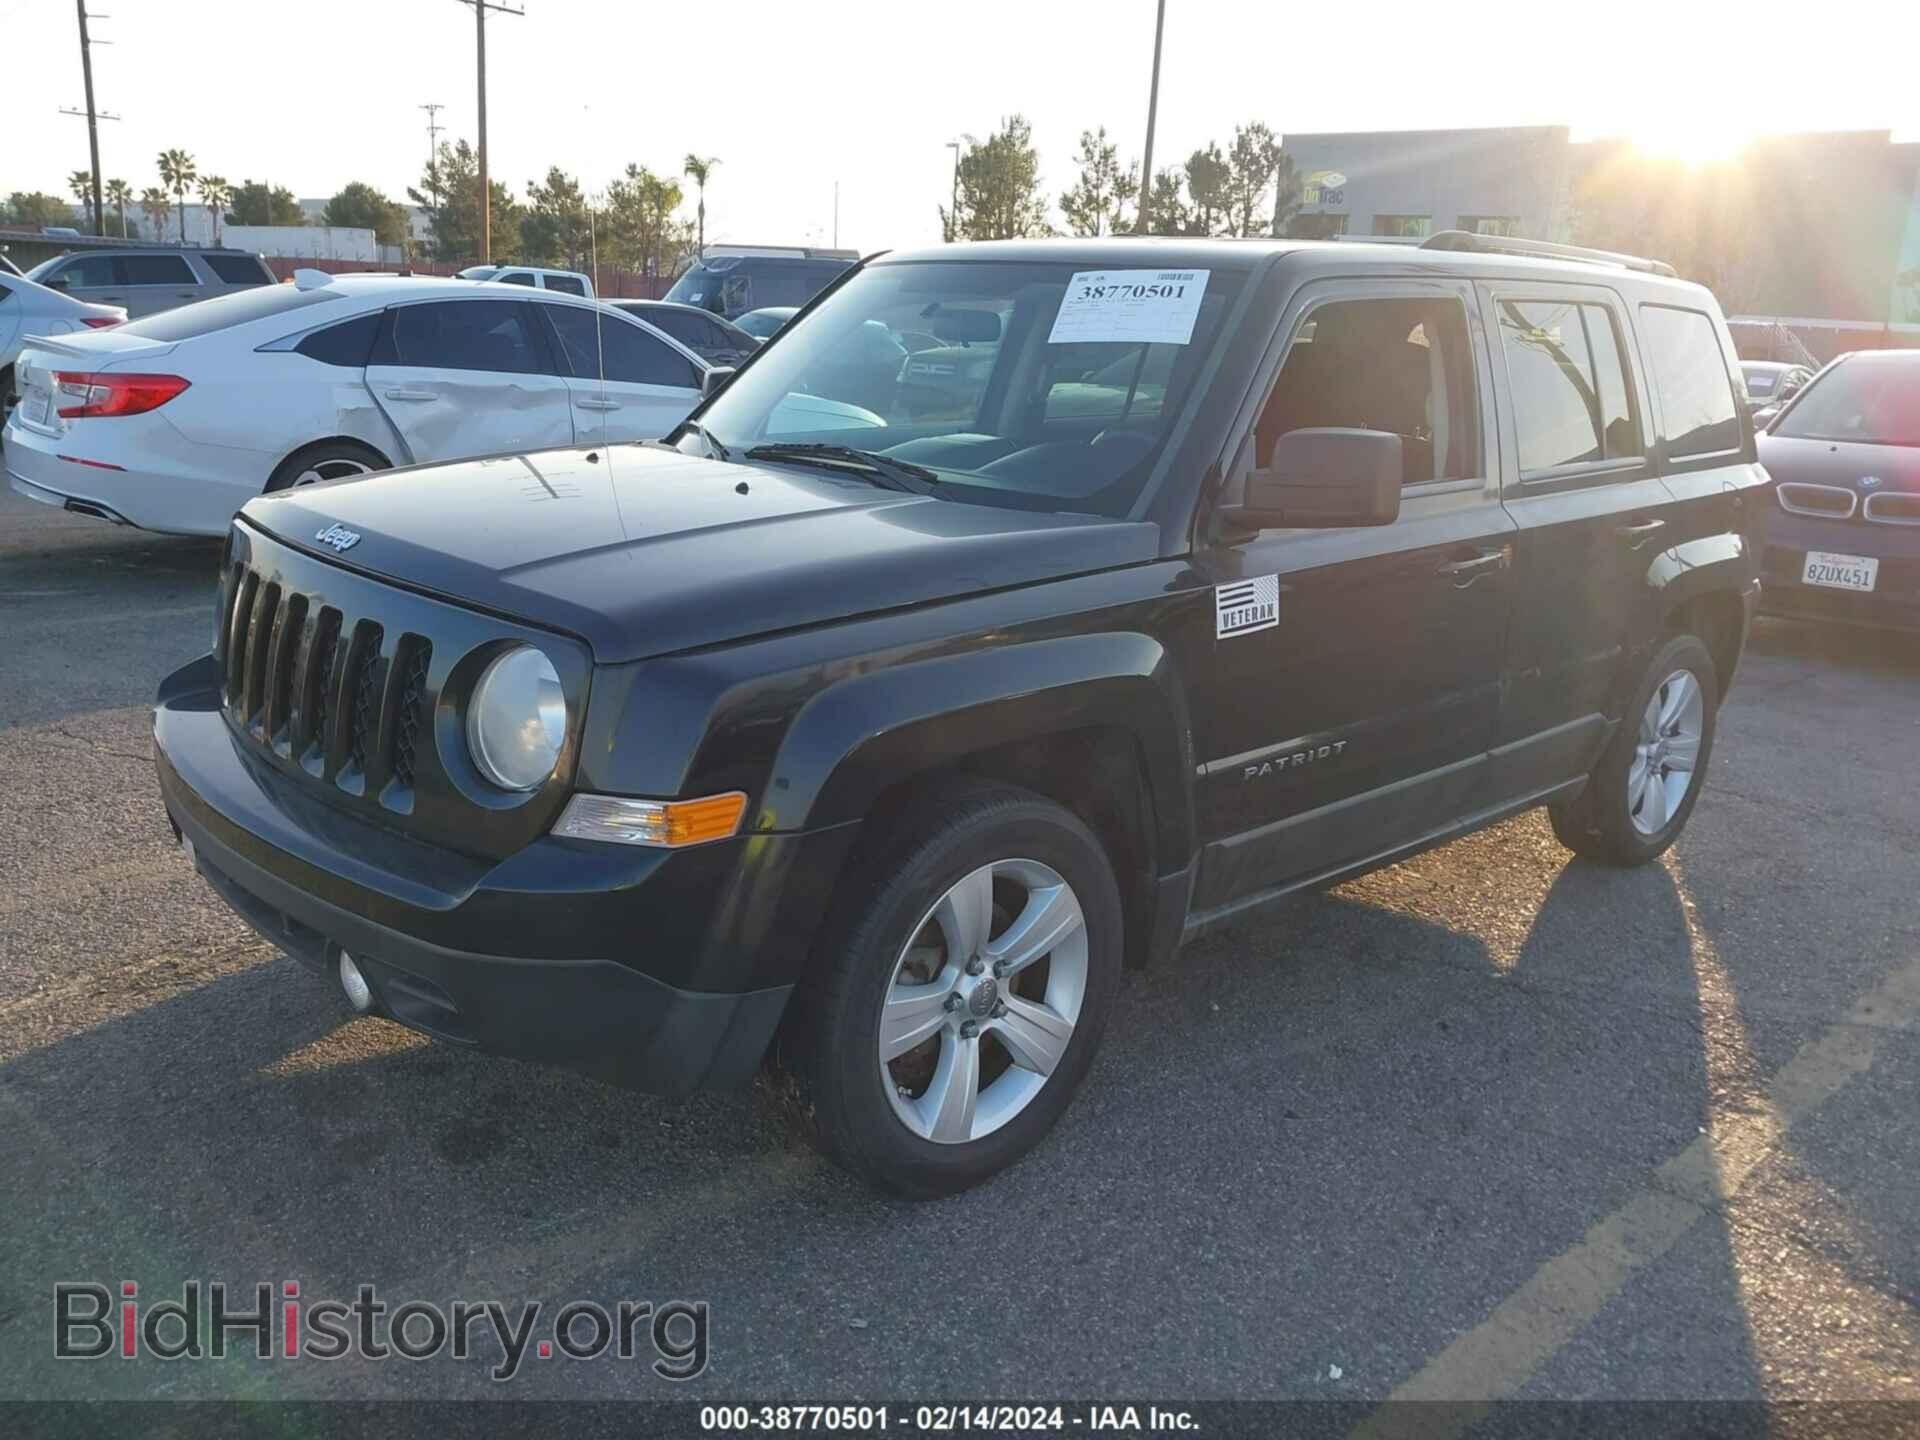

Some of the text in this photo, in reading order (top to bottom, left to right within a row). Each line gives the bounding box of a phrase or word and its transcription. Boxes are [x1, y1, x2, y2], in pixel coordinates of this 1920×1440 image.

[1077, 285, 1185, 300] 38770501
[315, 523, 361, 551] Jeep
[1807, 564, 1869, 586] 8ZUX451
[1222, 603, 1274, 628] VETERAN
[1244, 741, 1347, 780] PATRIOT
